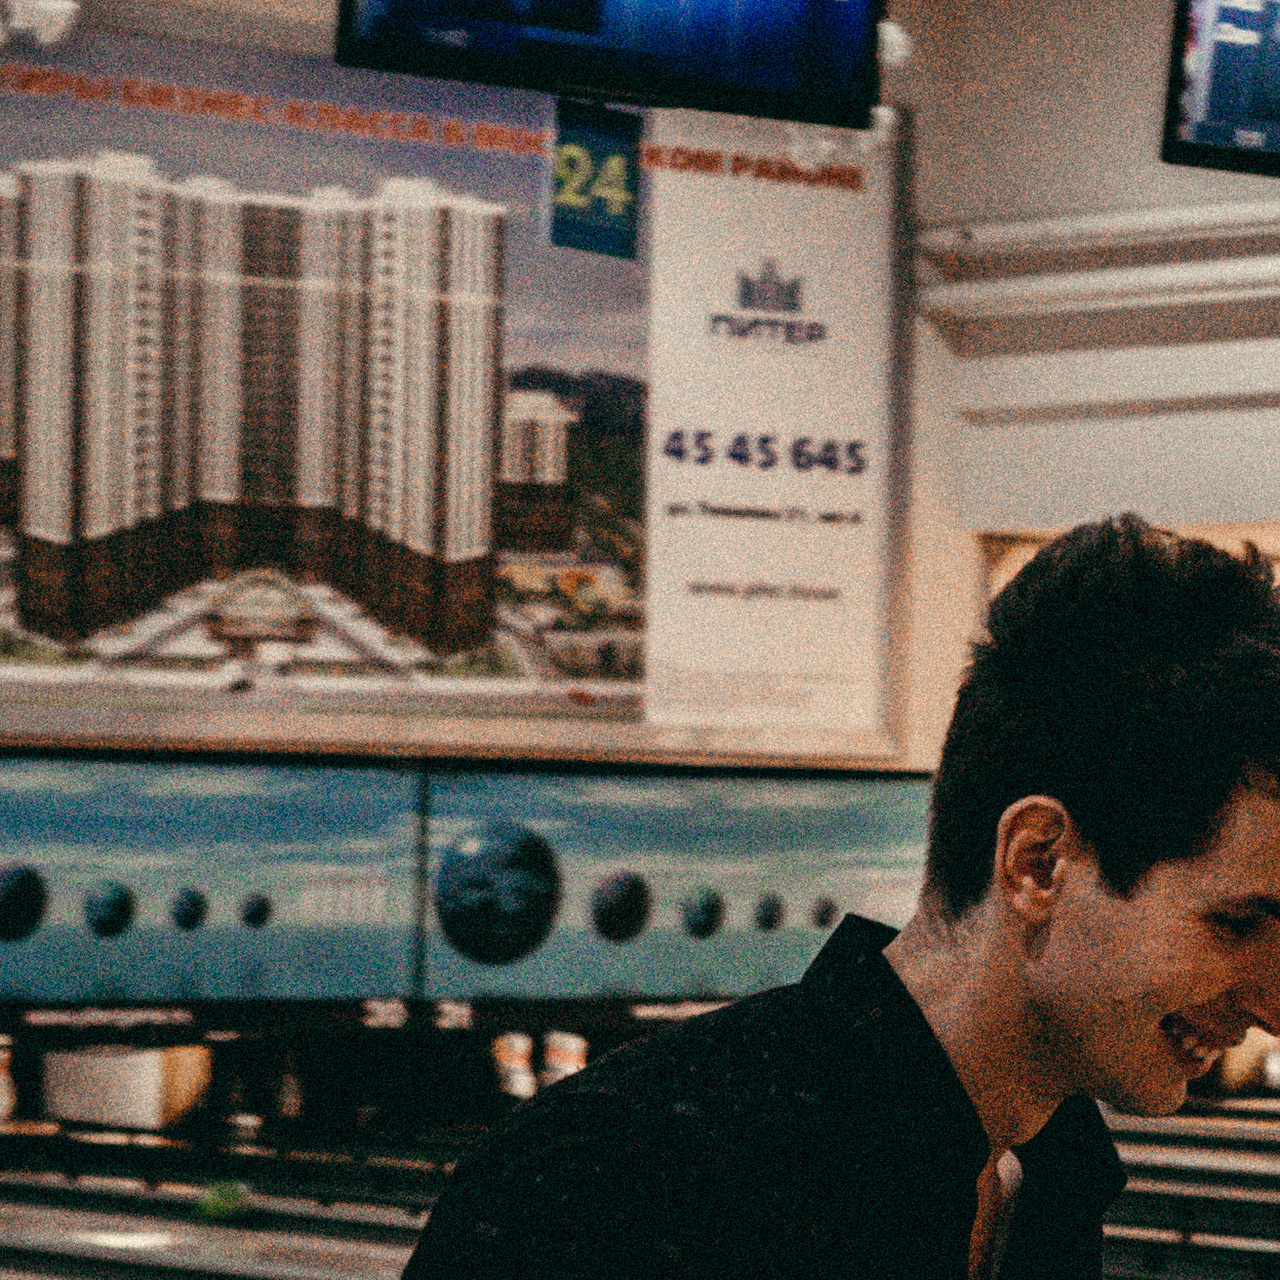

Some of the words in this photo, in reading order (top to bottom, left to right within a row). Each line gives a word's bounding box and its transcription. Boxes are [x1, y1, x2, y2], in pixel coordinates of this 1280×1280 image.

[555, 143, 635, 214] 24
[708, 312, 829, 345] ПИТЕР
[664, 428, 714, 466] 45
[727, 432, 777, 470] 45
[791, 436, 868, 475] 645
